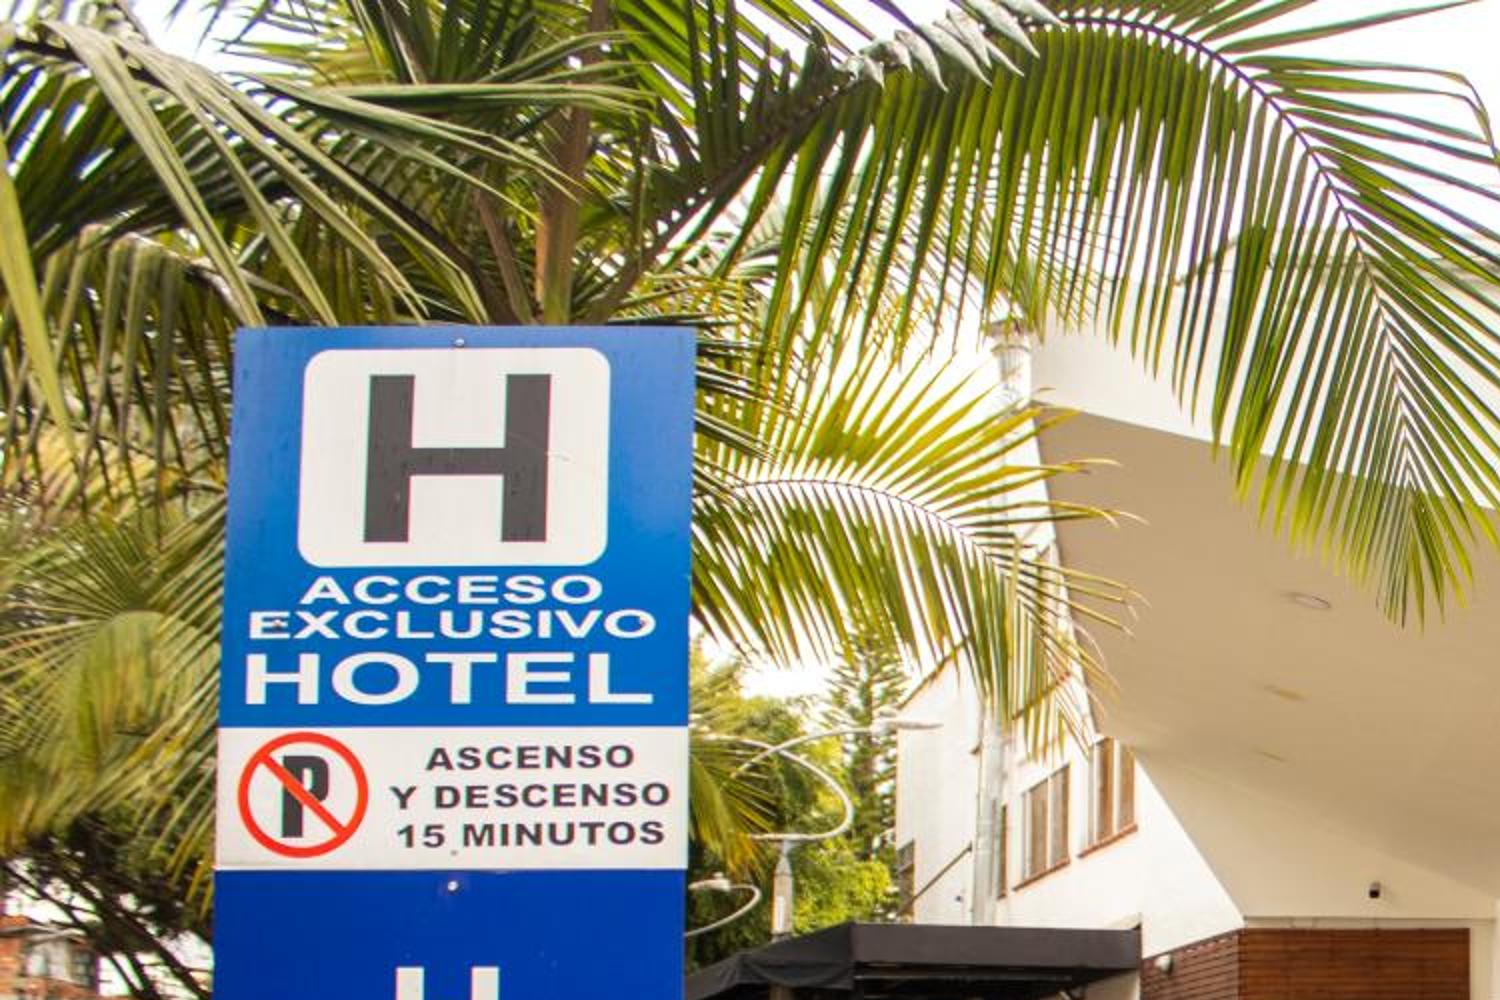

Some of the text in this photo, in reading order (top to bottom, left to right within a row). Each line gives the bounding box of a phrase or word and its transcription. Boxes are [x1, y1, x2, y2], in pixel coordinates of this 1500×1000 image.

[364, 373, 551, 543] H
[300, 575, 602, 605] ACCESO
[249, 609, 656, 639] EXCLUSIVO
[245, 652, 653, 705] HOTEL
[426, 745, 634, 771] ASCENSO
[391, 782, 670, 810] Y DESCENSO
[397, 821, 665, 848] 15 MINUTOS
